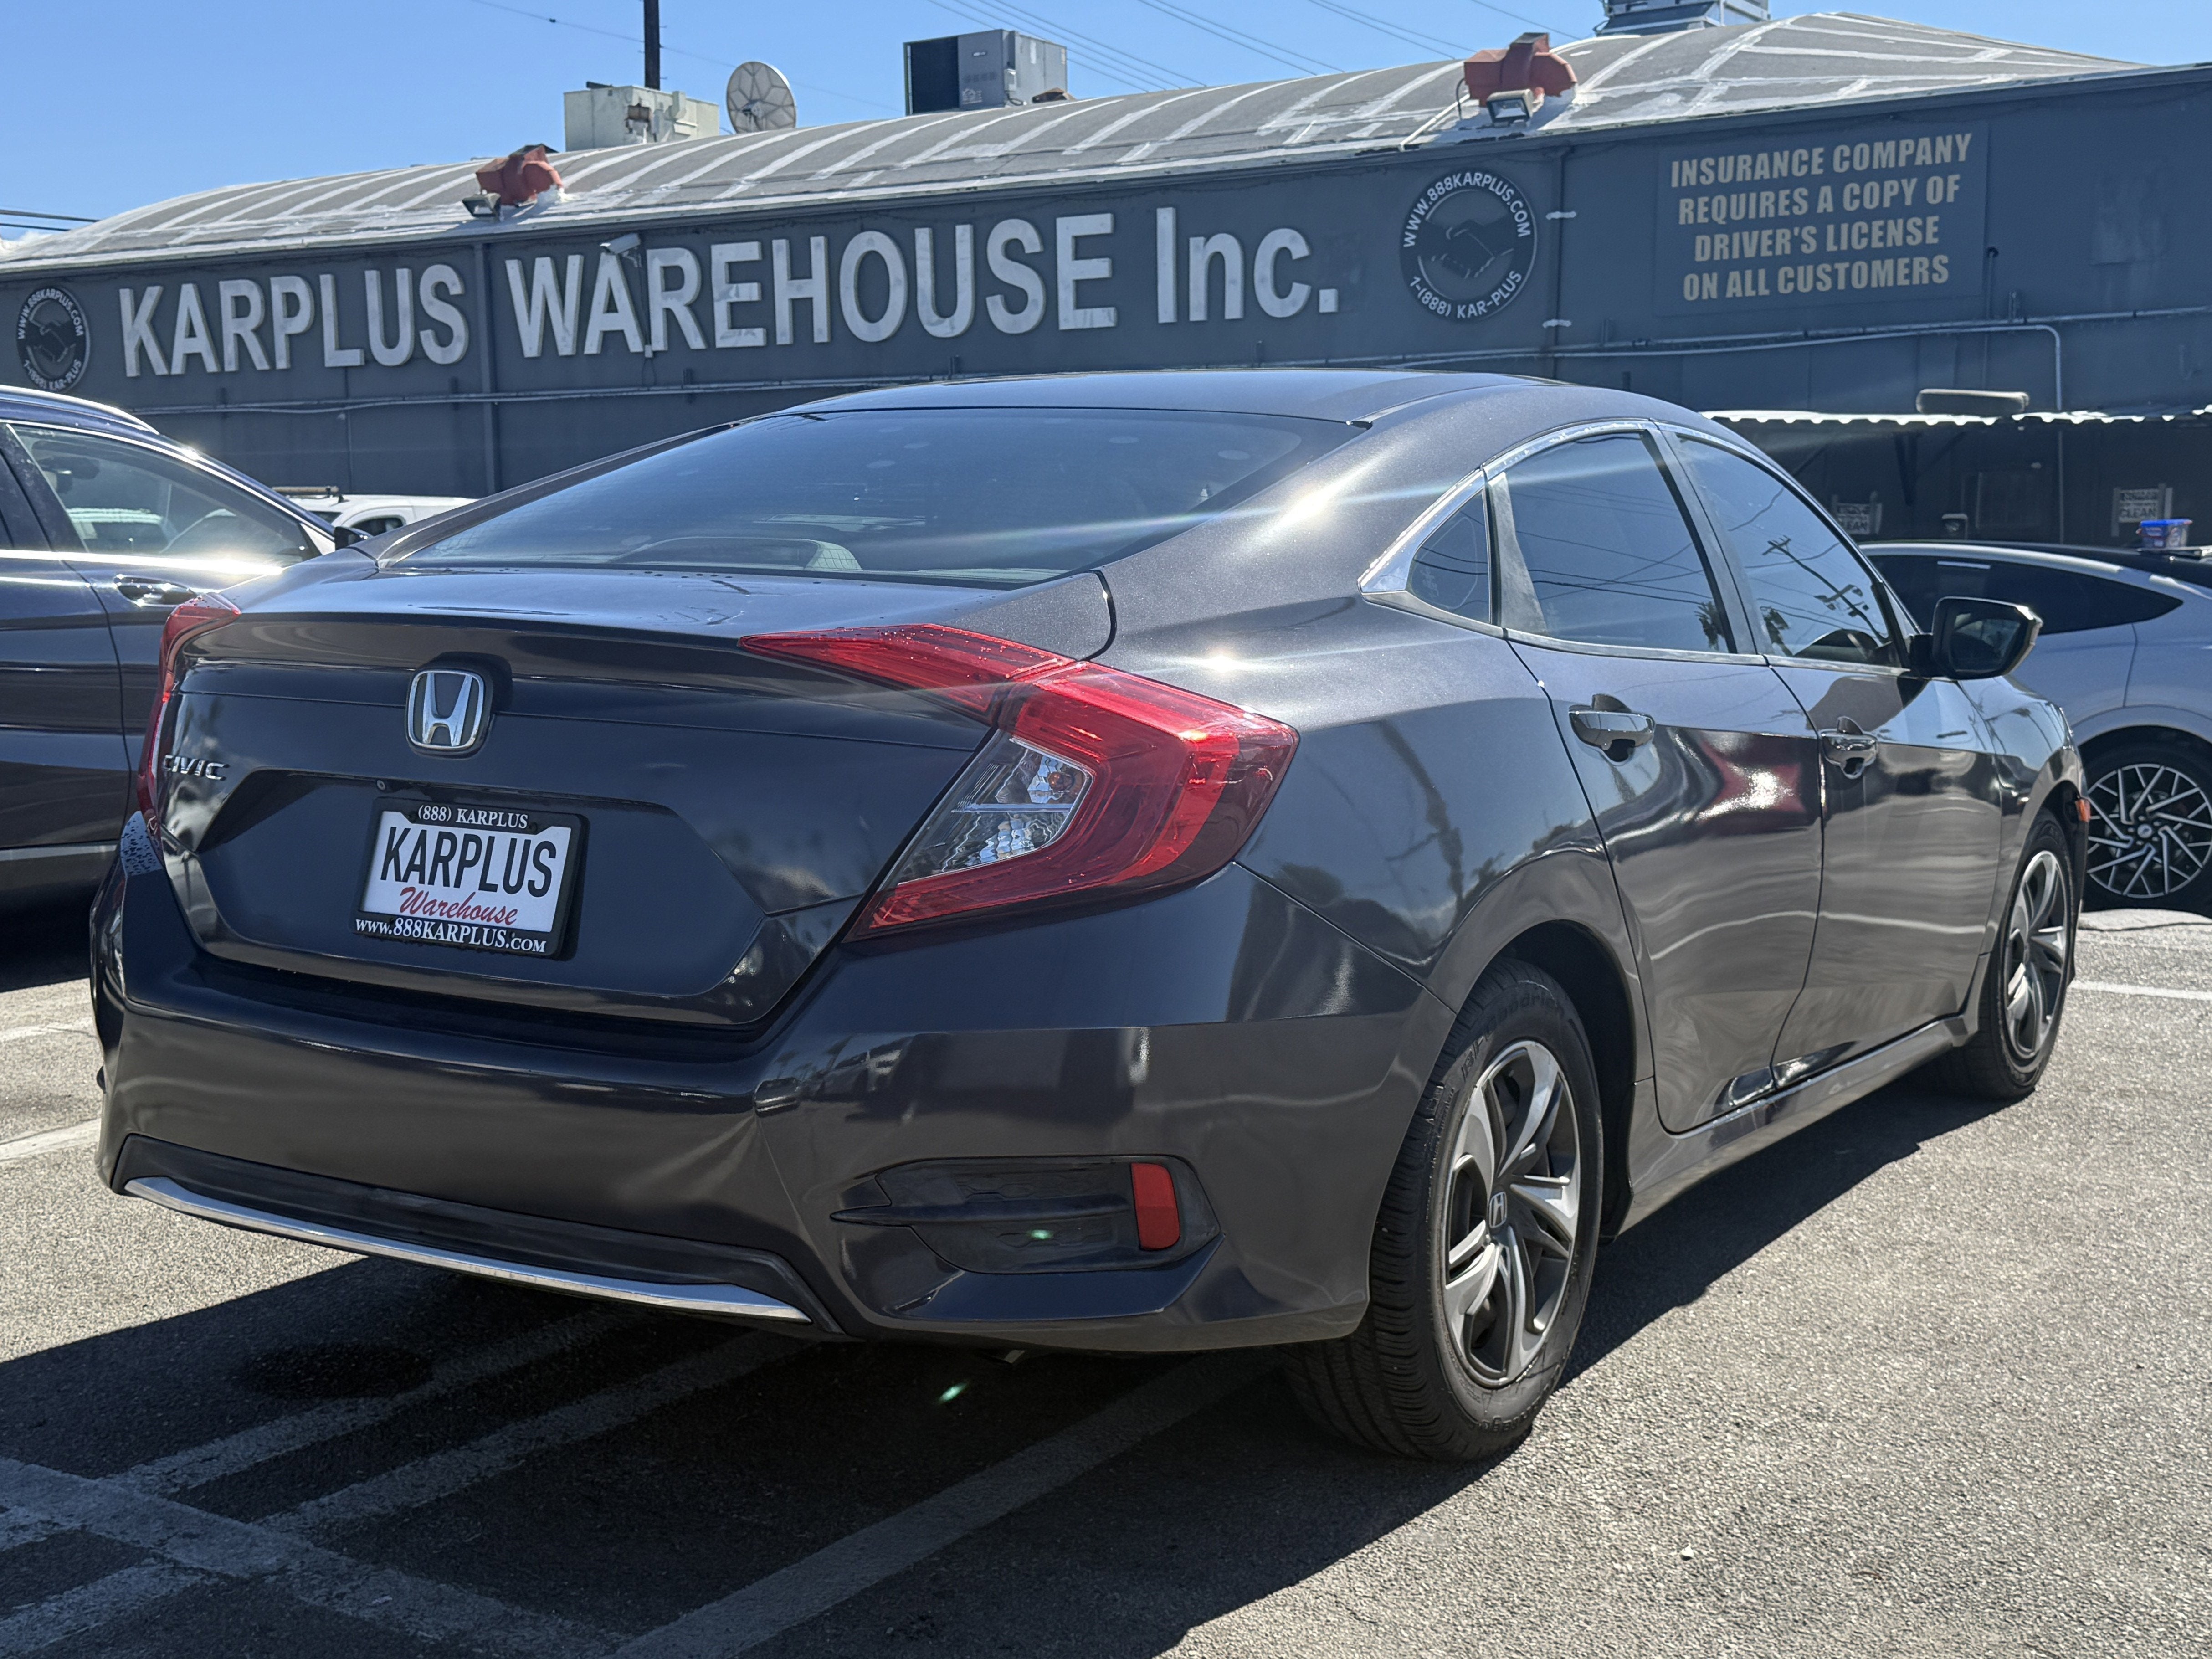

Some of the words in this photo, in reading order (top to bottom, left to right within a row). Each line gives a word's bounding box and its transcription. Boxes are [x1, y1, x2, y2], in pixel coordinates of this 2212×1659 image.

[1671, 148, 1824, 187] INSURANCE
[1833, 133, 1972, 173] COMPANY
[1403, 172, 1531, 247] WWW.888KARPLUS.COM
[1678, 187, 1809, 225] REQUIRES
[1817, 186, 1833, 213] A
[1842, 178, 1917, 211] COPY
[1926, 174, 1961, 205] OF
[1694, 226, 1817, 262] DRIVER'S
[1826, 216, 1940, 252] LICENSE
[119, 264, 469, 377] KARPLUS
[505, 213, 1118, 358] WAREHOUSE
[1156, 207, 1339, 324] Inc.
[1410, 276, 1452, 317] 1-(888)
[1457, 271, 1522, 319] KAR-PLUS
[1683, 272, 1718, 302] ON
[1726, 268, 1770, 298] ALL
[1778, 255, 1950, 294] CUSTOMERS
[18, 288, 84, 339] WWW.888KARPLUS.COM
[163, 755, 231, 781] CIVIC
[418, 805, 452, 822] (888)
[456, 808, 528, 829] KARPLUS
[380, 826, 557, 898] KARPLUS
[400, 886, 518, 925] Warehouse
